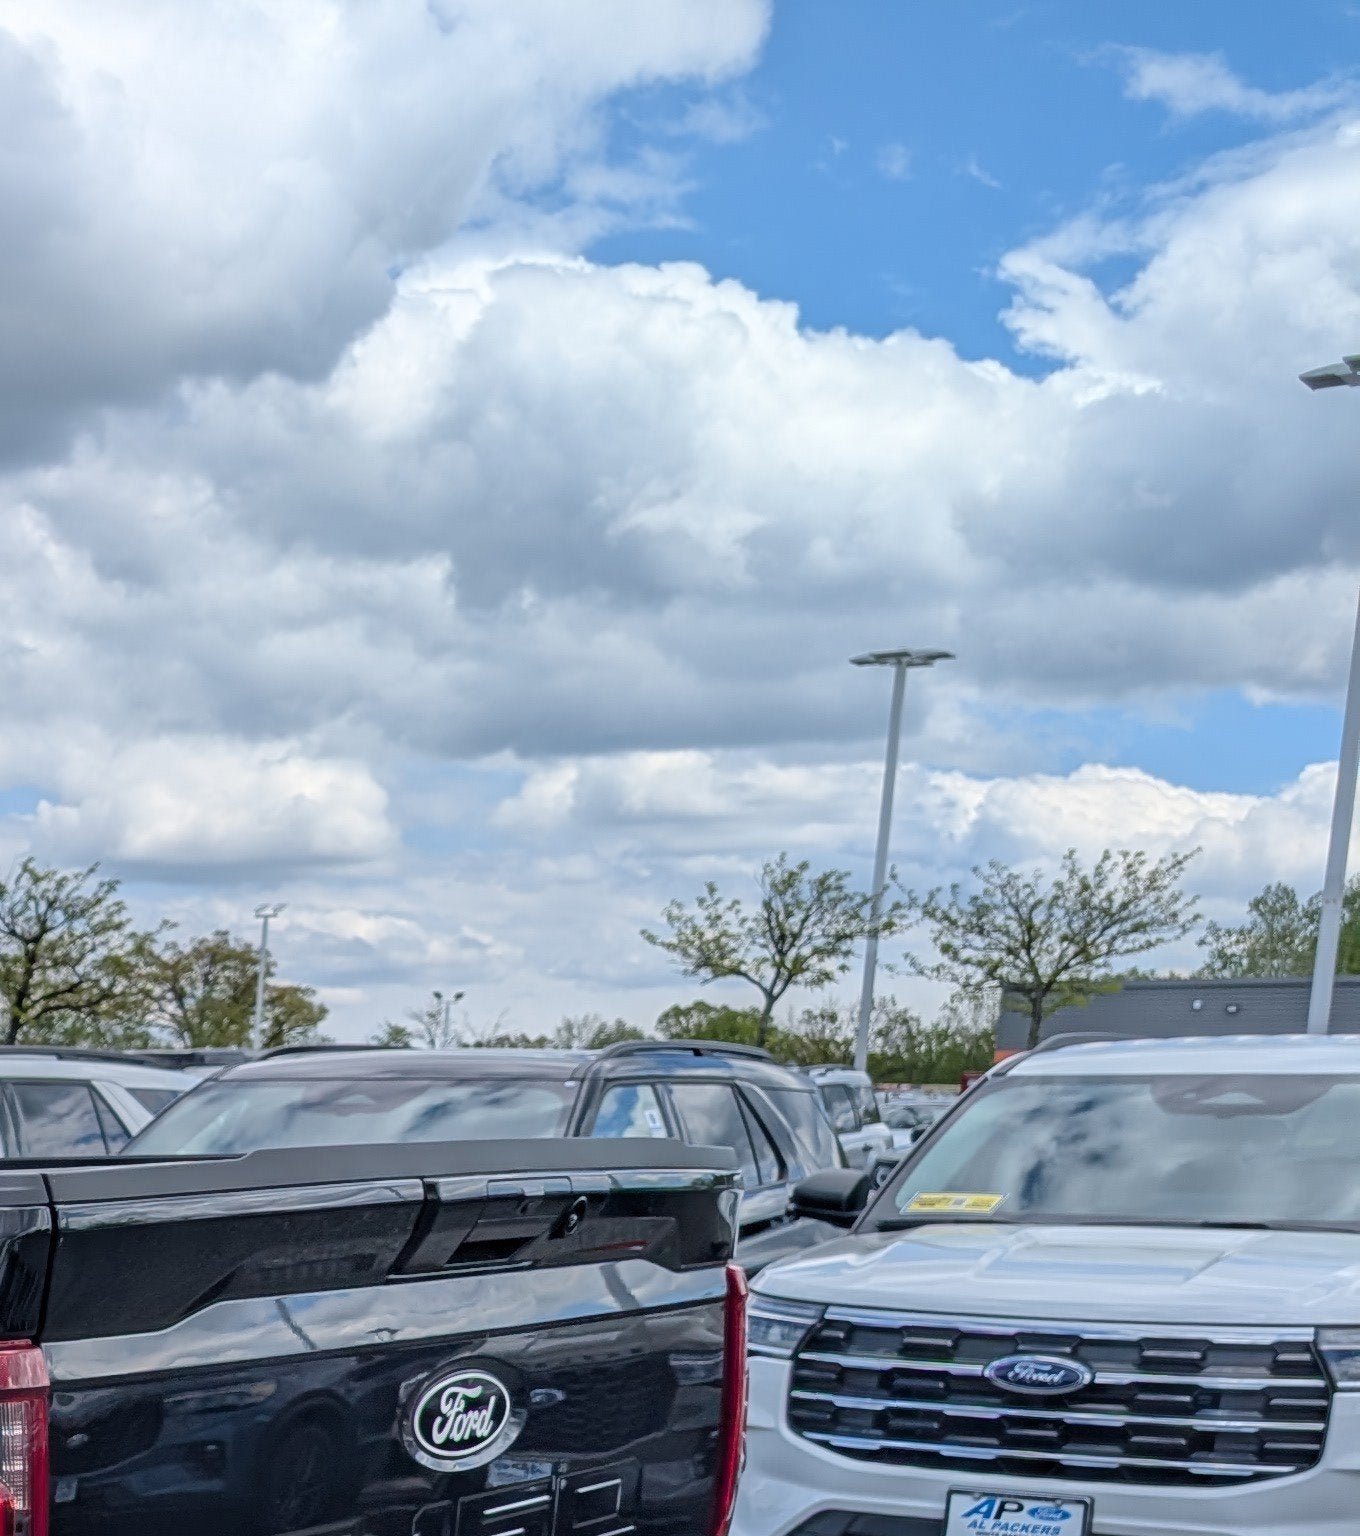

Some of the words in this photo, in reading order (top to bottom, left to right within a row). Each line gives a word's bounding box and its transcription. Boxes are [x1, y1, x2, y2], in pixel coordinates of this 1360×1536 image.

[1007, 1361, 1065, 1385] Ford
[431, 1384, 497, 1444] Ford
[961, 1496, 1024, 1520] AP
[966, 1519, 986, 1530] AL
[991, 1521, 1062, 1536] PACKERS
